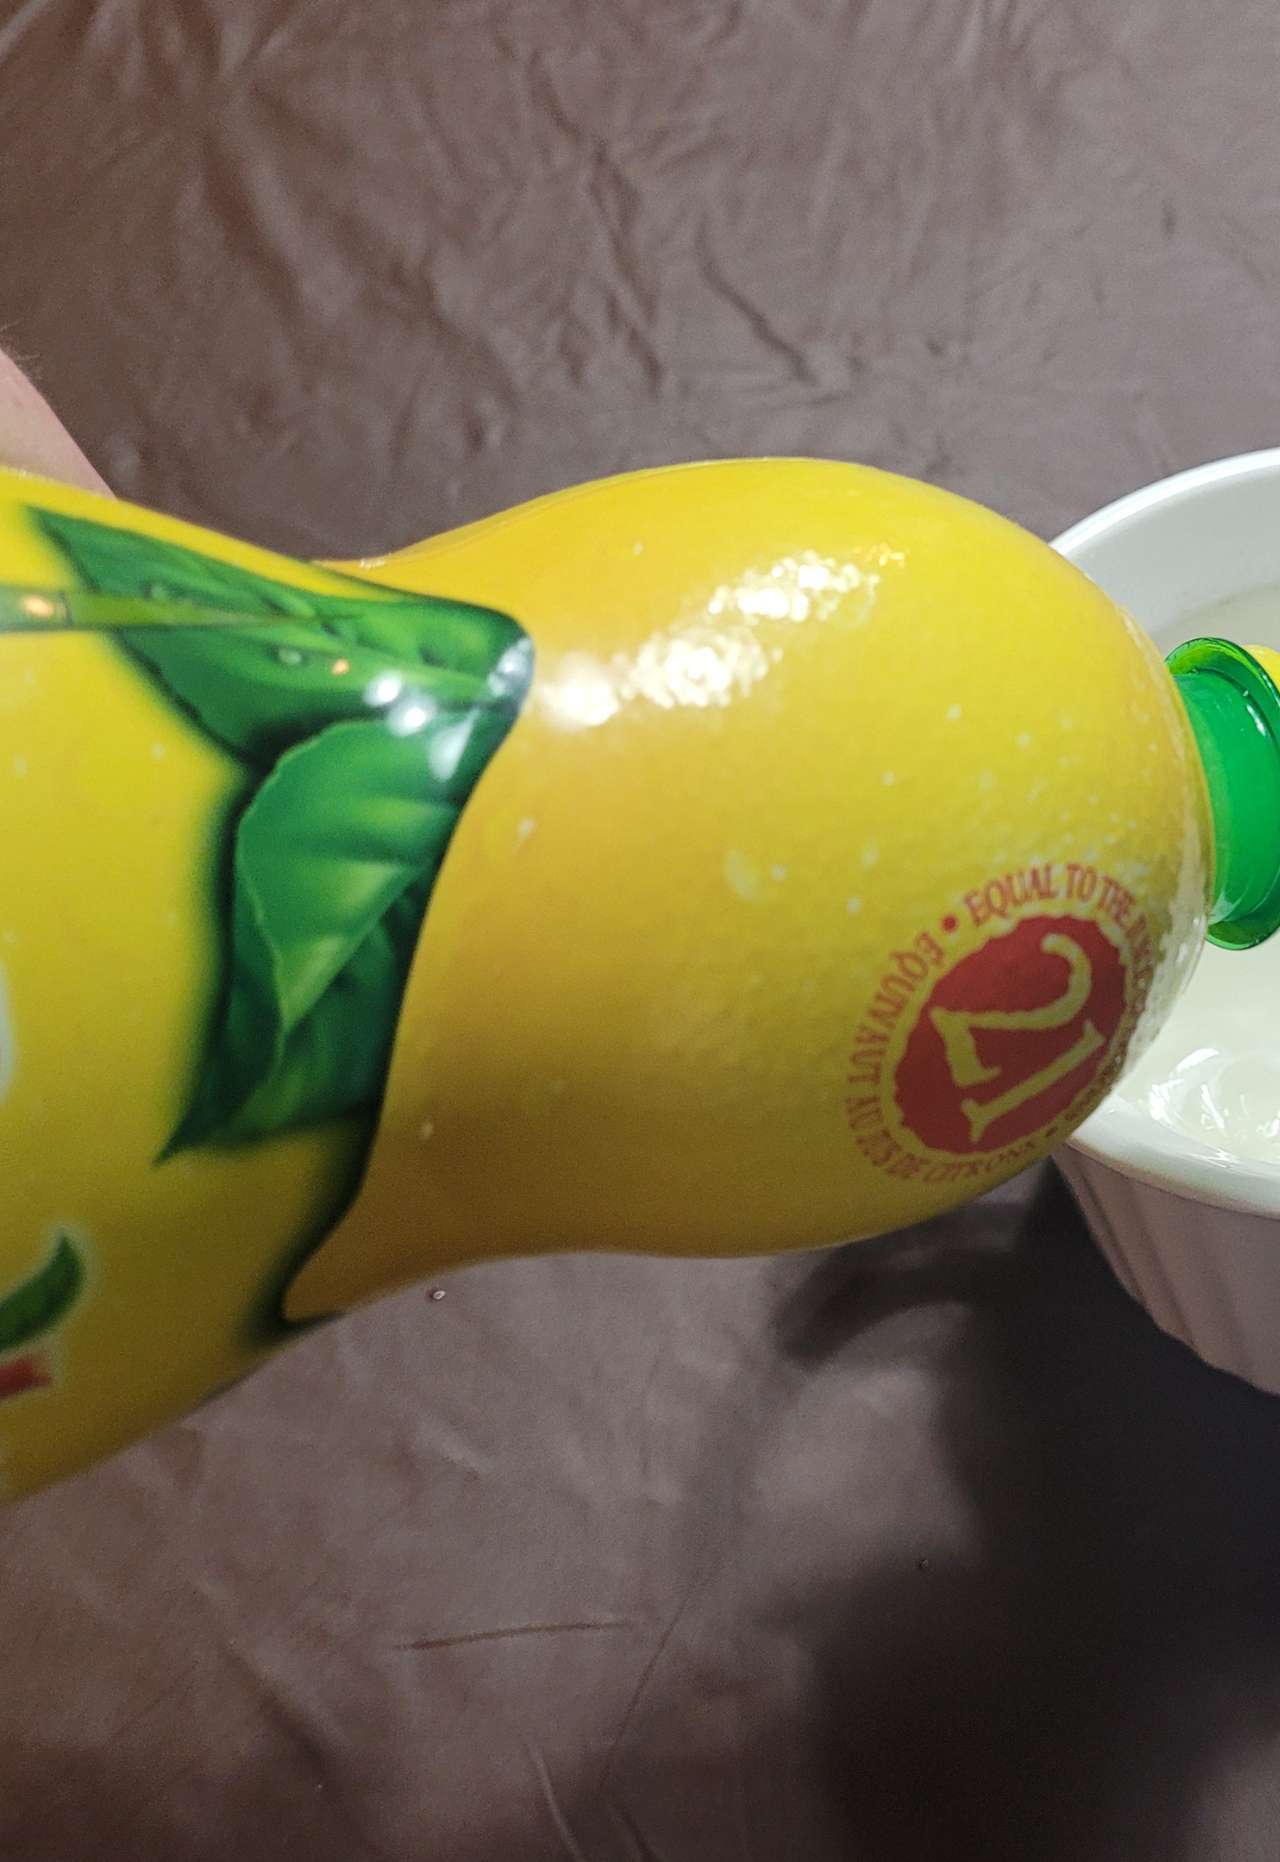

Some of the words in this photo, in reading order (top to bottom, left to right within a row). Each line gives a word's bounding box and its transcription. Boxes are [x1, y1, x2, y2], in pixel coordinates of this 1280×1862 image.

[962, 863, 1056, 929] EQUAL
[1066, 861, 1098, 903] TO
[929, 931, 1107, 1144] 21
